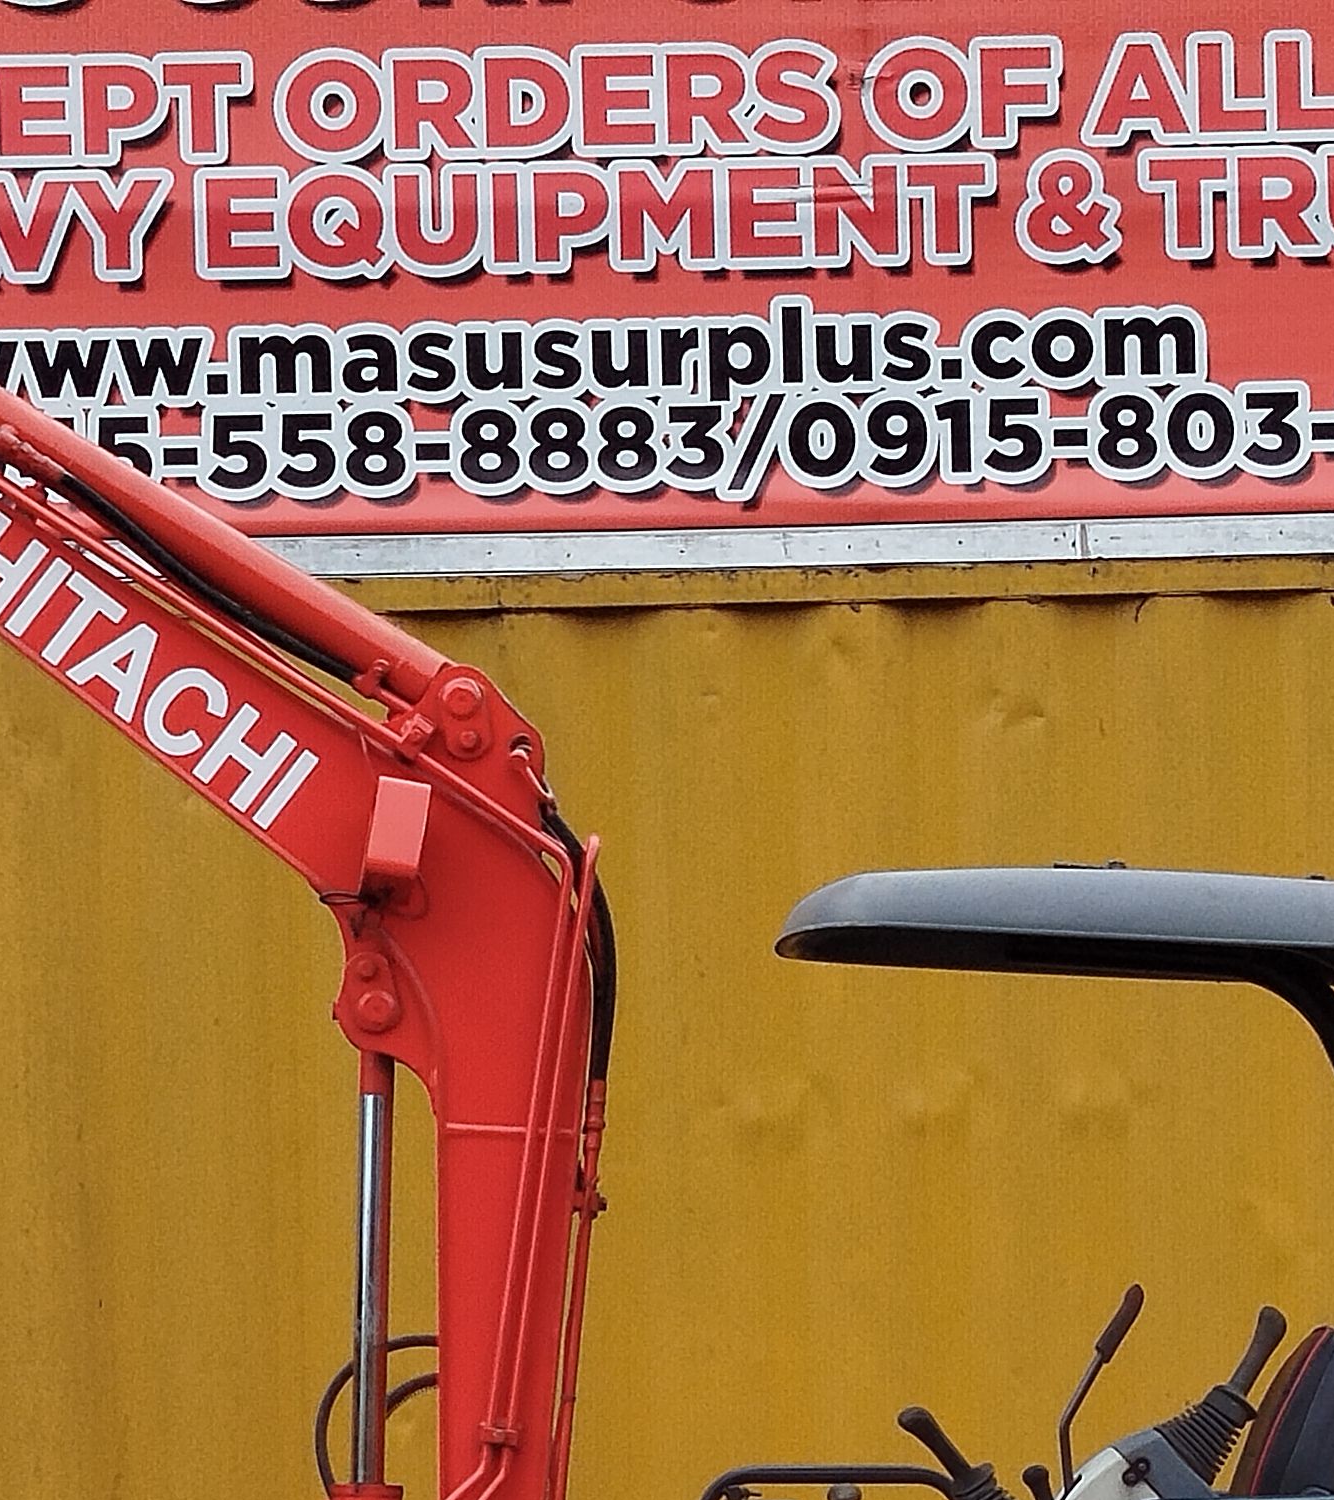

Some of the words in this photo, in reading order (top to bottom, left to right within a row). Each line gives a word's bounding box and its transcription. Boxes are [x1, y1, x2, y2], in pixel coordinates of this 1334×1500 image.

[275, 41, 838, 164] ORDERS
[858, 35, 1062, 152] OF
[193, 150, 997, 284] EQUIPMENT
[1015, 147, 1123, 266] &
